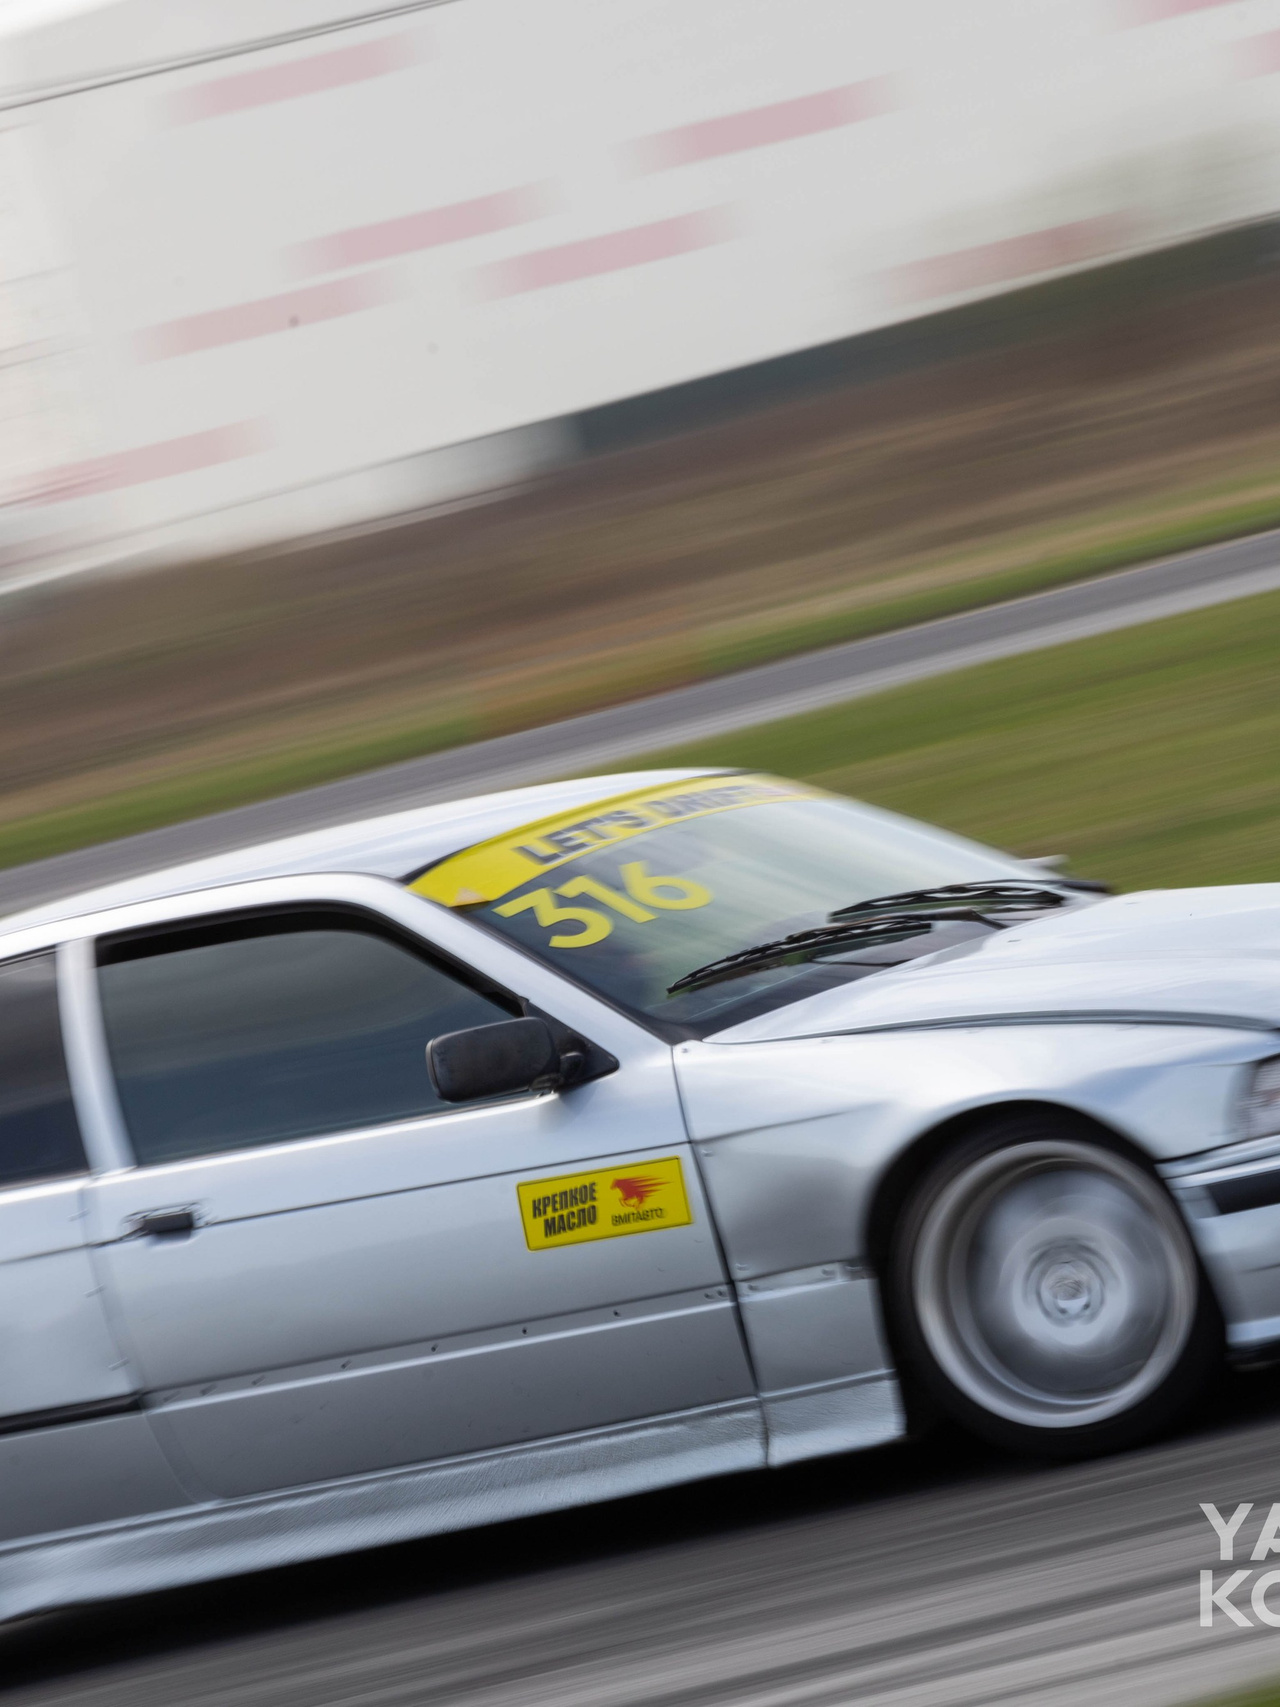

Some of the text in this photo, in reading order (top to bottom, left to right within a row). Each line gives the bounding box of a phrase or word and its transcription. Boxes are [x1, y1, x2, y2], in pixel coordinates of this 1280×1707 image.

[492, 860, 714, 949] 316
[531, 1182, 598, 1219] КРЕПКОЕ
[543, 1205, 598, 1238] МАСЛО
